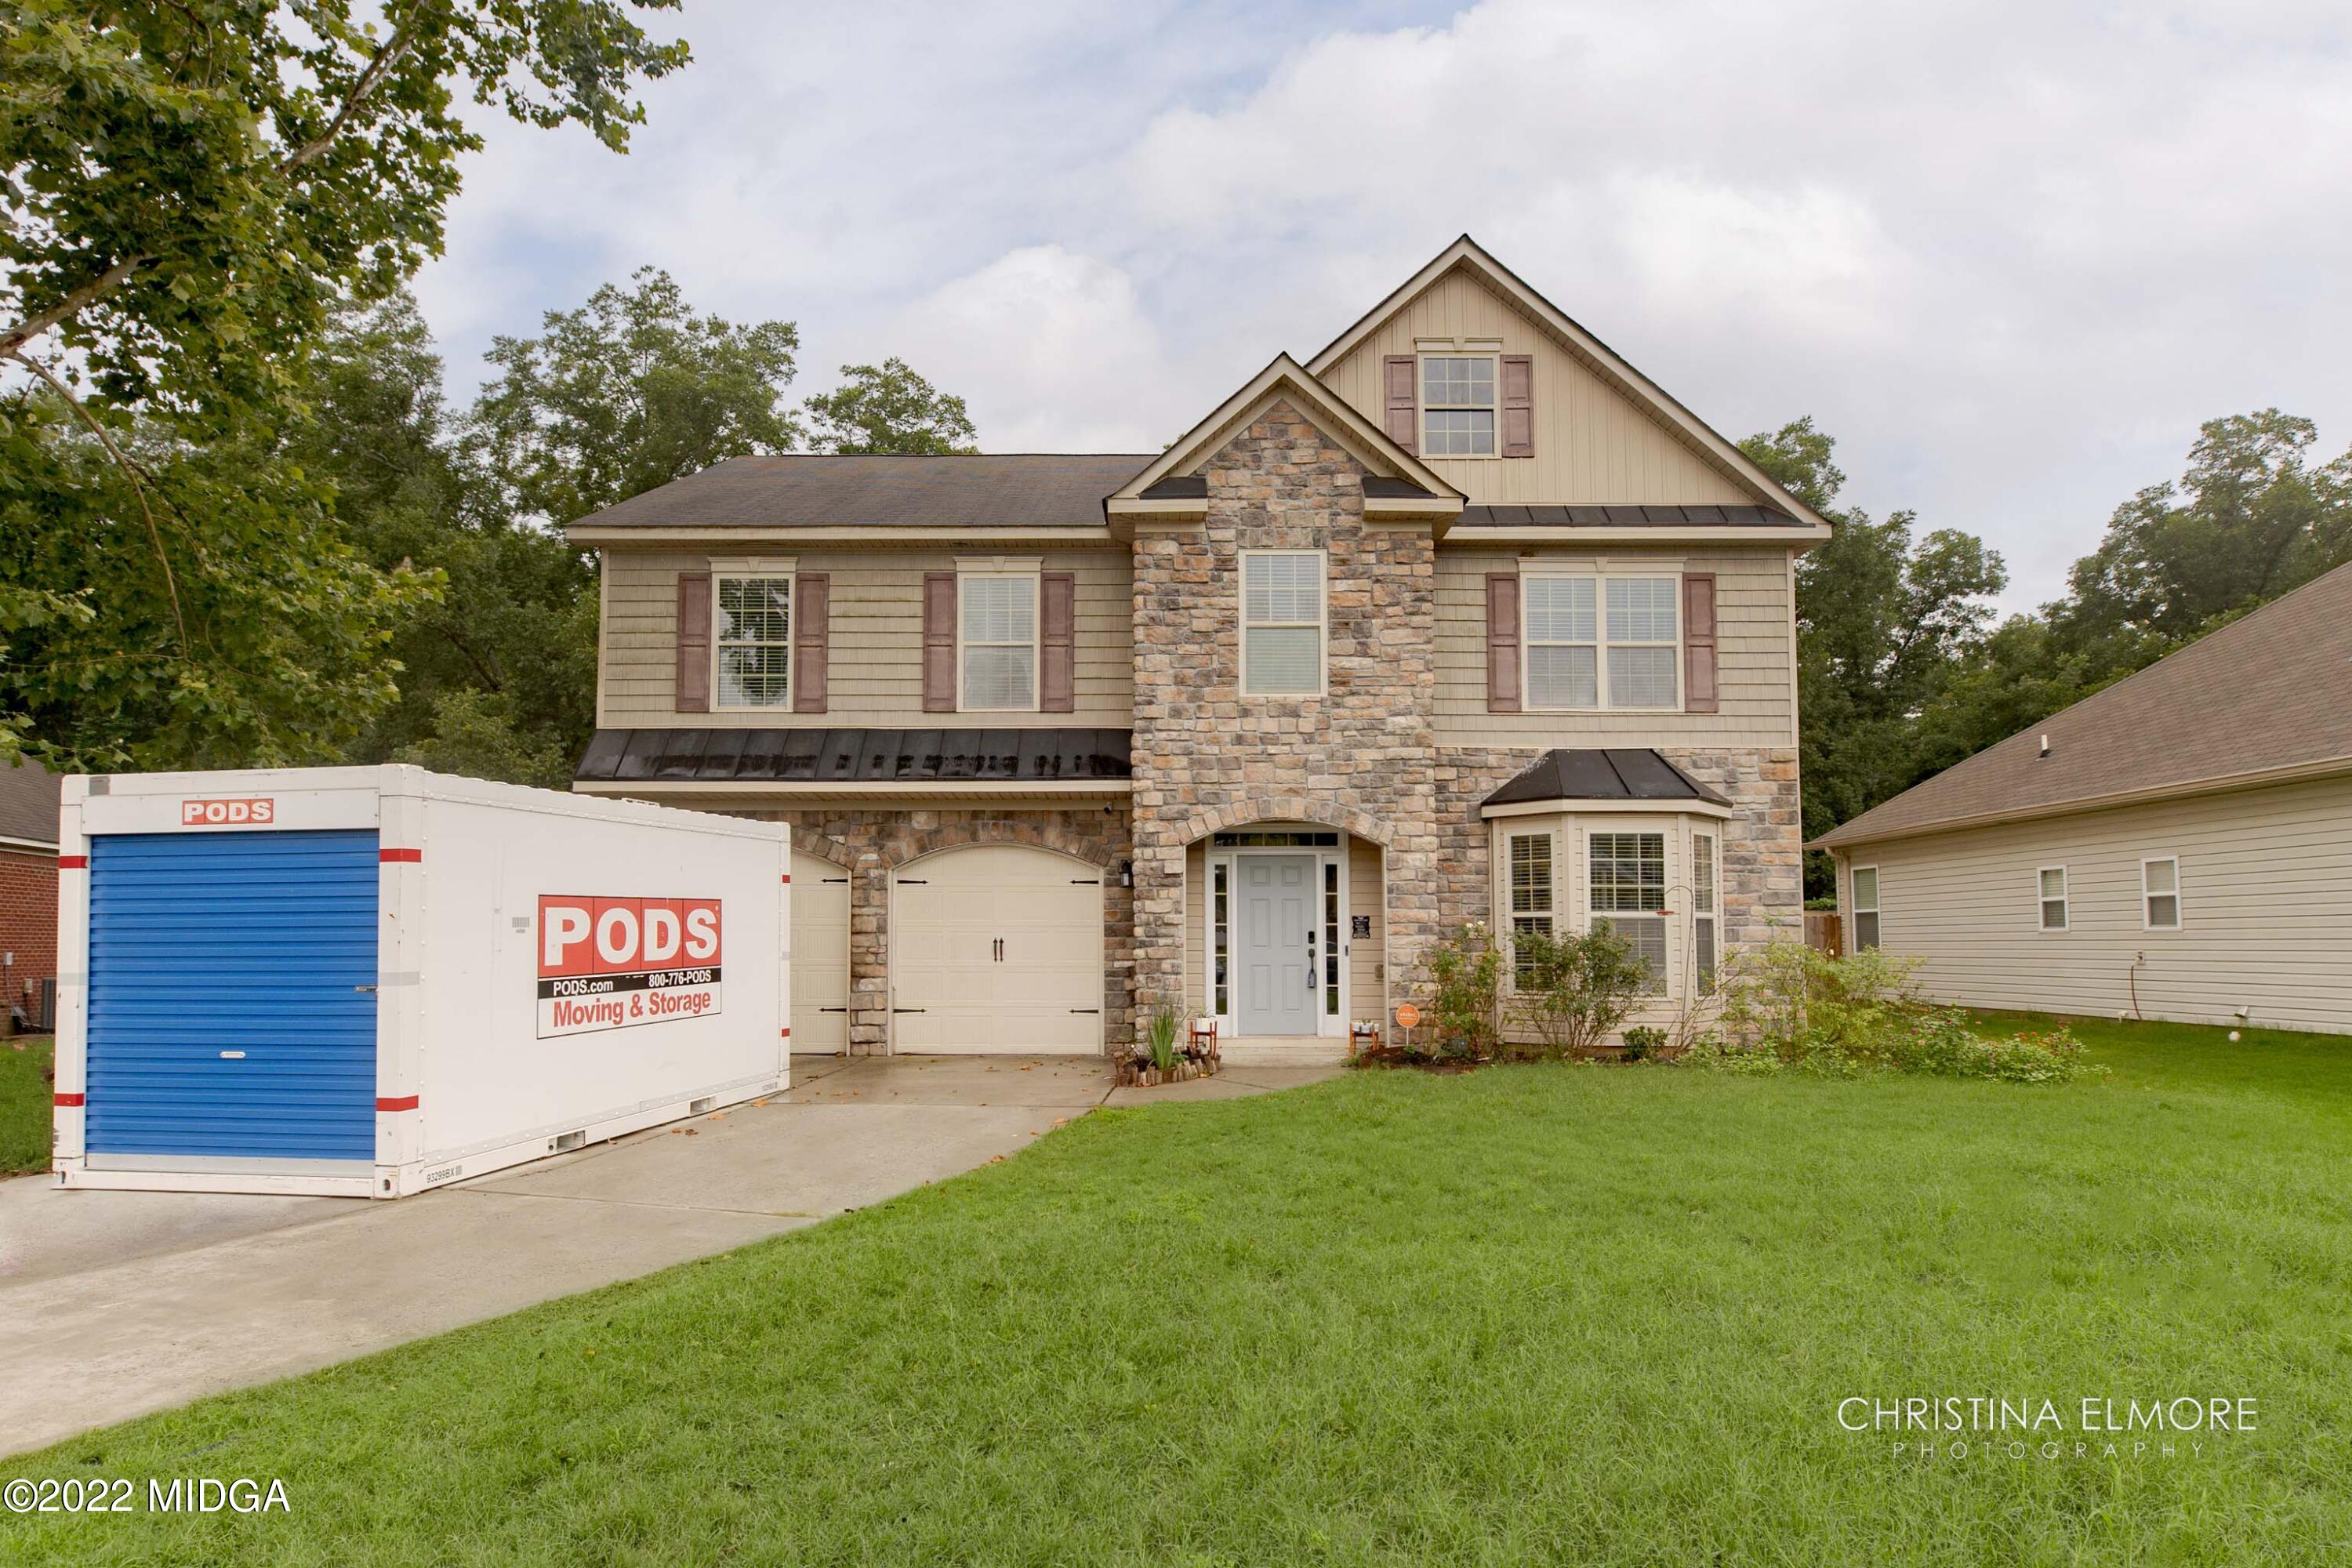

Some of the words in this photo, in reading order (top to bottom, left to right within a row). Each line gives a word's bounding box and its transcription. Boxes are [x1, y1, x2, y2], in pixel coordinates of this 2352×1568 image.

[184, 801, 271, 822] PODS
[544, 907, 718, 967] PODS
[553, 979, 614, 996] PODS.com
[648, 969, 712, 988] 800-776-PODS
[554, 997, 624, 1028] Moving
[630, 993, 644, 1018] &
[648, 992, 711, 1015] Storage
